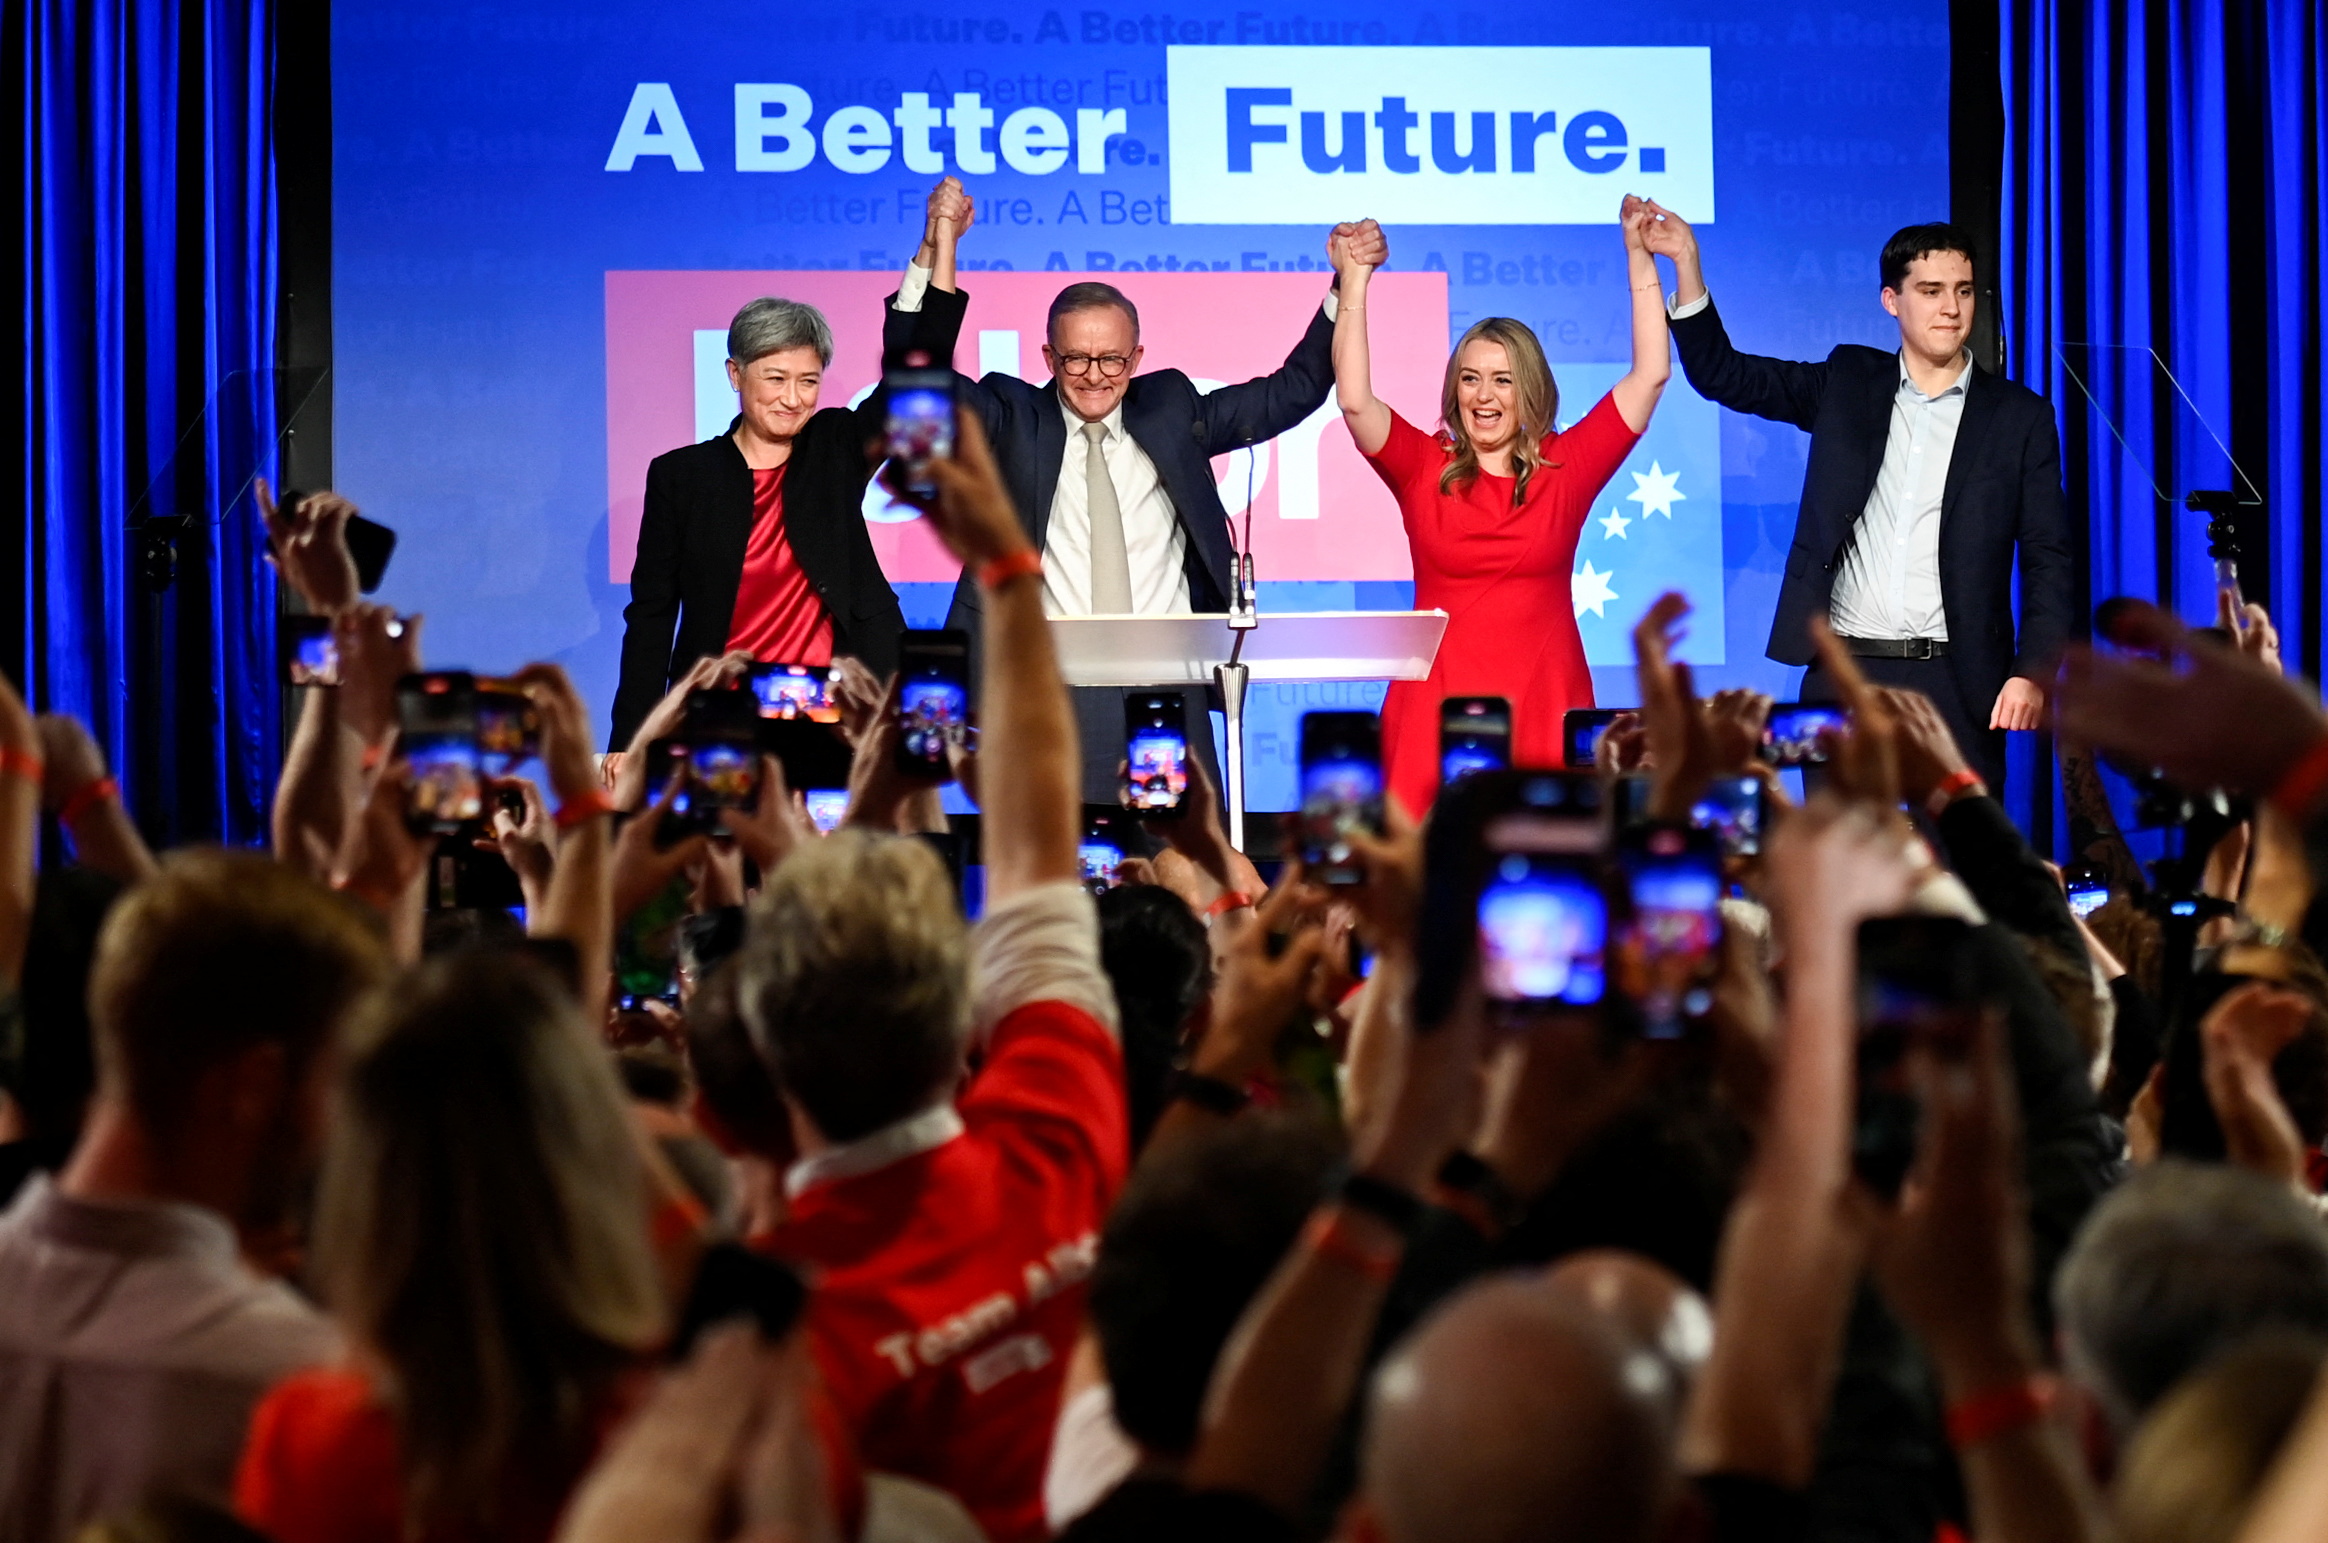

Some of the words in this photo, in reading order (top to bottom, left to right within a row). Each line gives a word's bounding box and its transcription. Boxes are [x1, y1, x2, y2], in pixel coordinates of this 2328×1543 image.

[855, 11, 1023, 45] Future.
[1033, 11, 1071, 45] A
[1080, 11, 1226, 46] Better
[1236, 12, 1400, 45] Future.
[604, 82, 704, 172] A
[734, 82, 1127, 175] Better
[1226, 87, 1667, 174] Future.
[1057, 190, 1088, 225] A
[1461, 251, 1601, 286] Better
